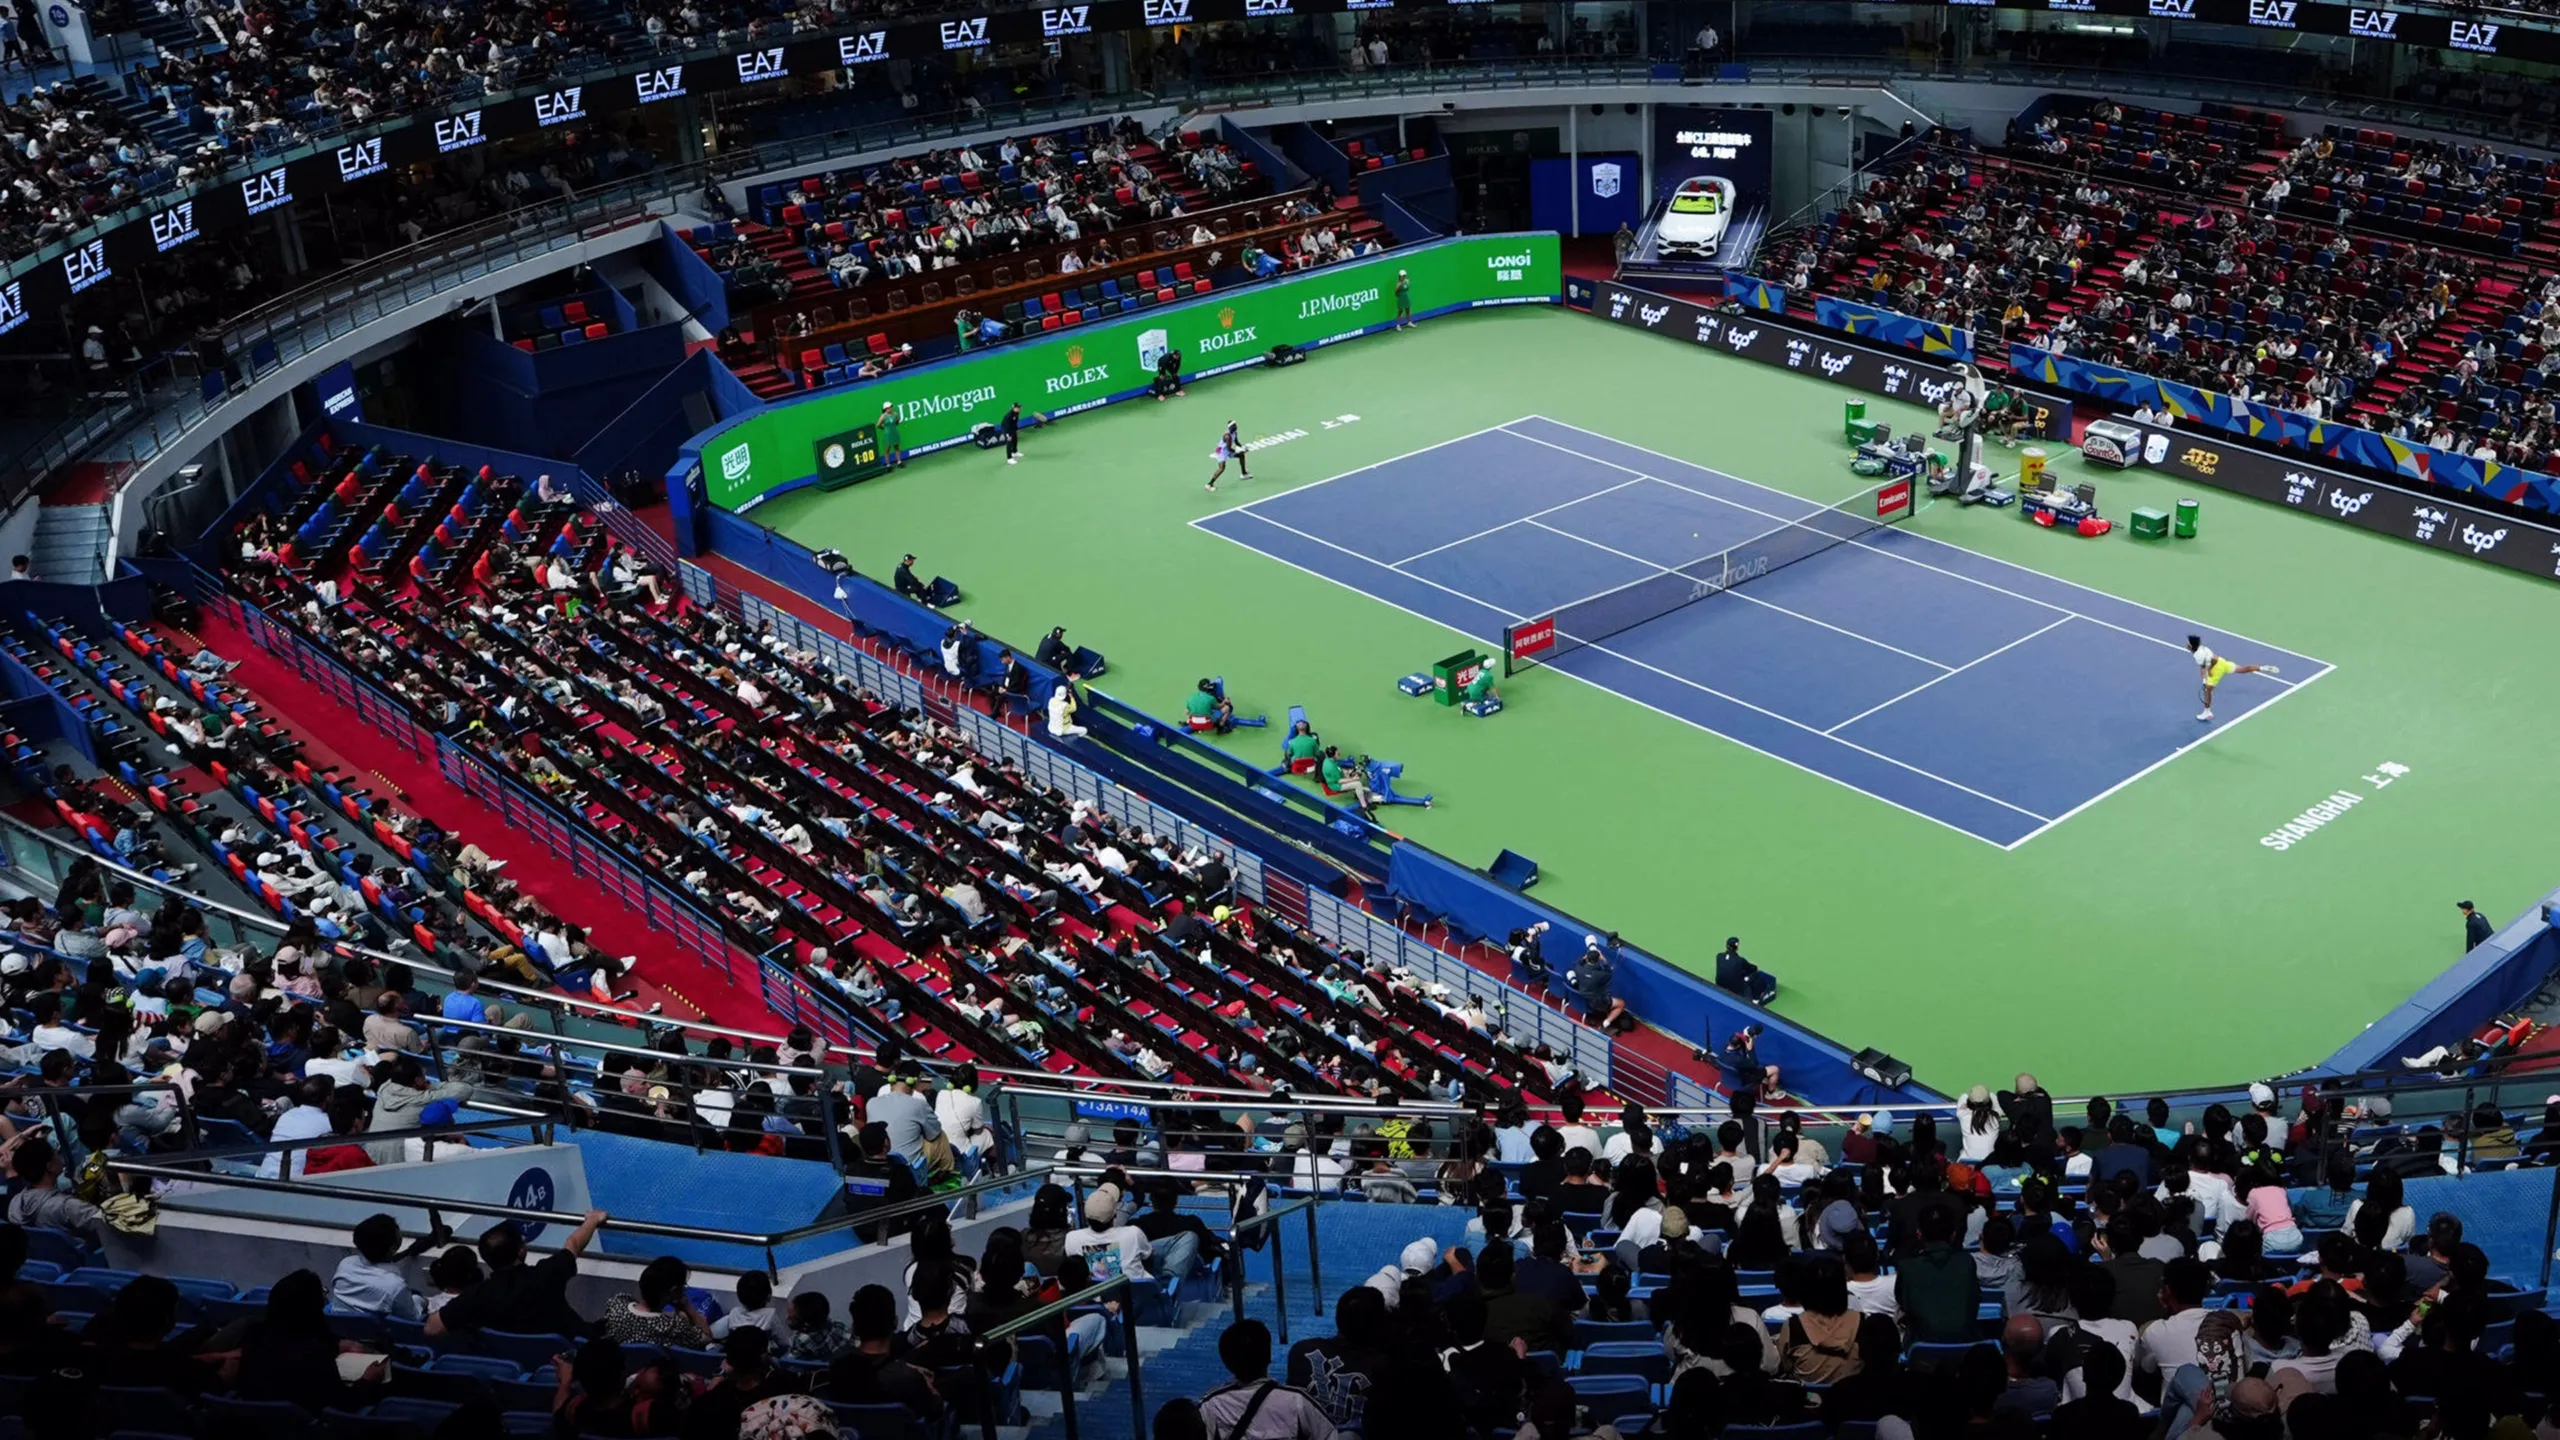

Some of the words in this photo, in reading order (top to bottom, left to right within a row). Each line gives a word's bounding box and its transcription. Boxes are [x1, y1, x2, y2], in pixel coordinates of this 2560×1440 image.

[1043, 6, 1088, 30] EA7
[1144, 0, 1189, 19] EA7
[2250, 0, 2296, 21] EA7
[2350, 9, 2397, 32] EA7
[941, 18, 987, 43] EA7
[2451, 21, 2498, 45] EA7
[839, 32, 885, 58] EA7
[737, 48, 783, 76] EA7
[636, 66, 681, 96] EA7
[535, 87, 580, 119] EA7
[435, 111, 480, 145] EA7
[338, 138, 381, 174] EA7
[242, 168, 285, 206] EA7
[151, 202, 191, 243] EA7
[64, 240, 103, 284] EA7
[0, 282, 21, 325] A7
[1298, 287, 1379, 319] J.P.Morgan
[1199, 326, 1258, 353] ROLEX
[1045, 364, 1109, 393] ROLEX
[897, 385, 997, 423] J.P.Morgan
[851, 437, 873, 449] ROLEX
[854, 449, 875, 465] 1:00
[2181, 447, 2219, 466] ATP
[724, 447, 748, 472] 光明
[2198, 464, 2216, 475] 1000
[1879, 491, 1907, 508] Emirates
[2330, 488, 2361, 516] tcp
[2462, 523, 2495, 553] tcp
[1727, 556, 1768, 586] TOUR
[2259, 789, 2364, 851] SHANGHAI
